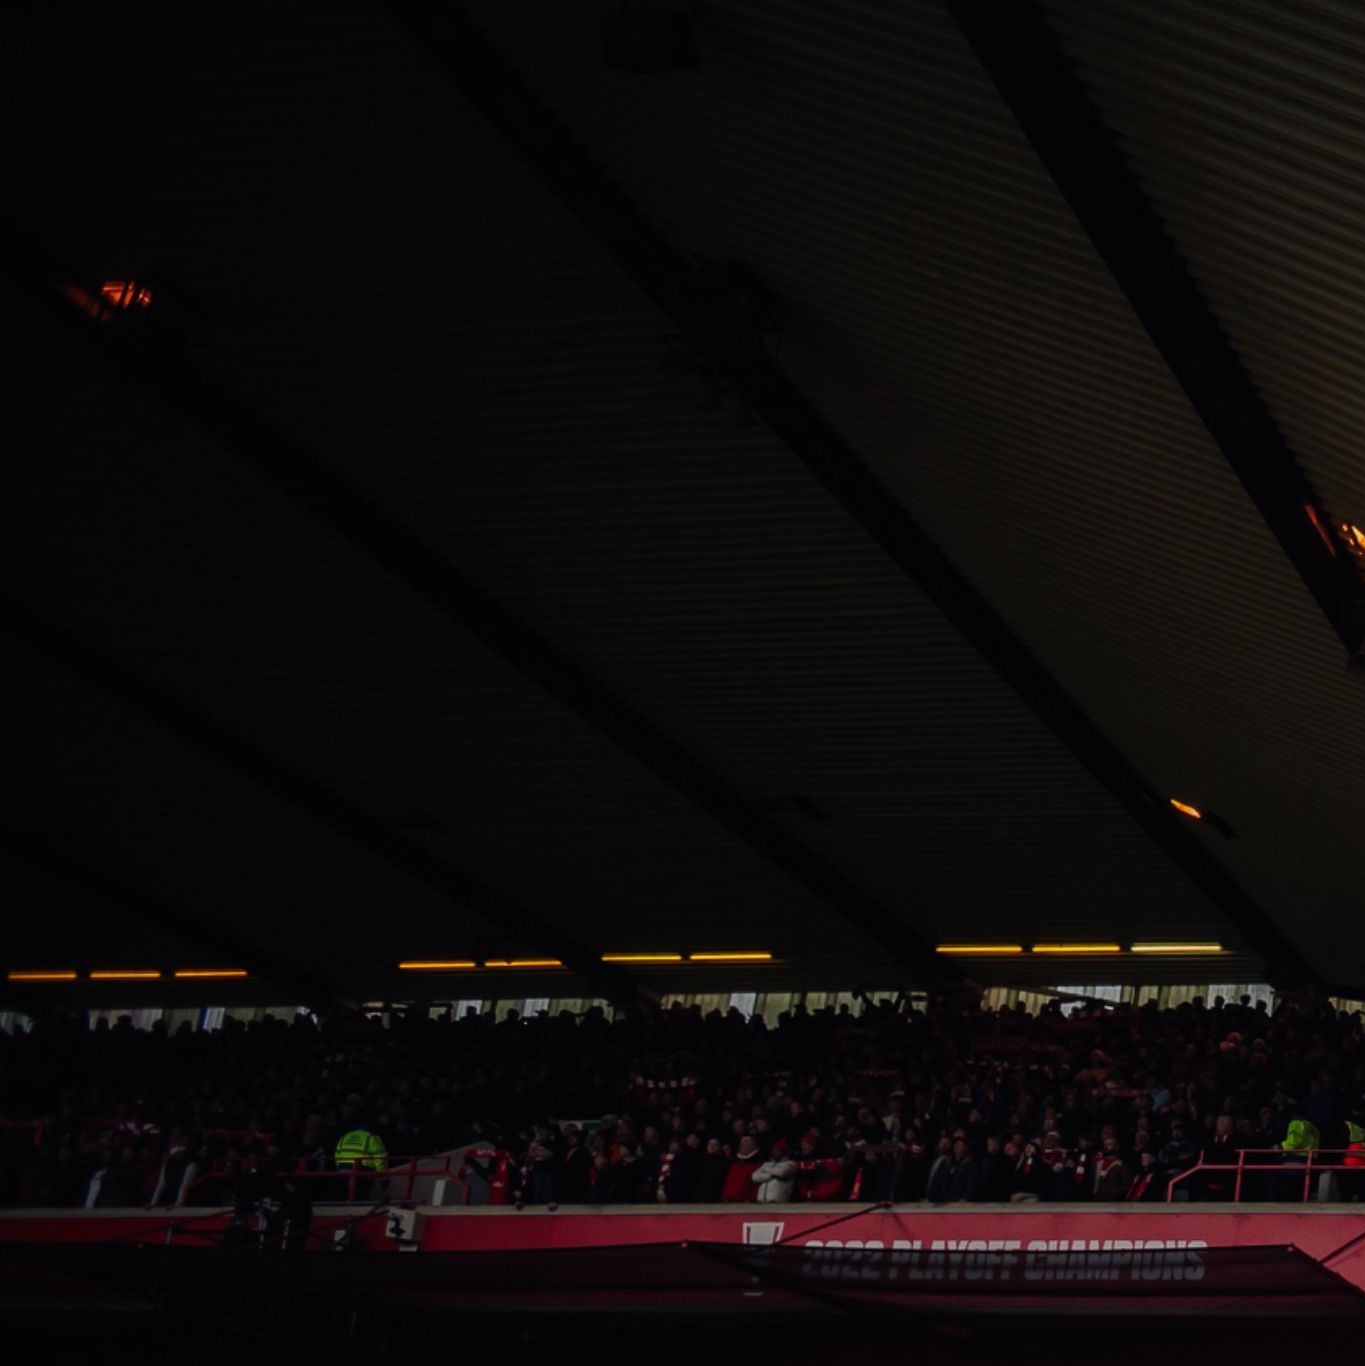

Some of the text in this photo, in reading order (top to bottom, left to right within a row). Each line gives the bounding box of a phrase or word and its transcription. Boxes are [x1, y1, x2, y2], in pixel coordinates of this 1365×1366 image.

[802, 1240, 1208, 1281] 2022 PLAYOFF CHAMPIONS
